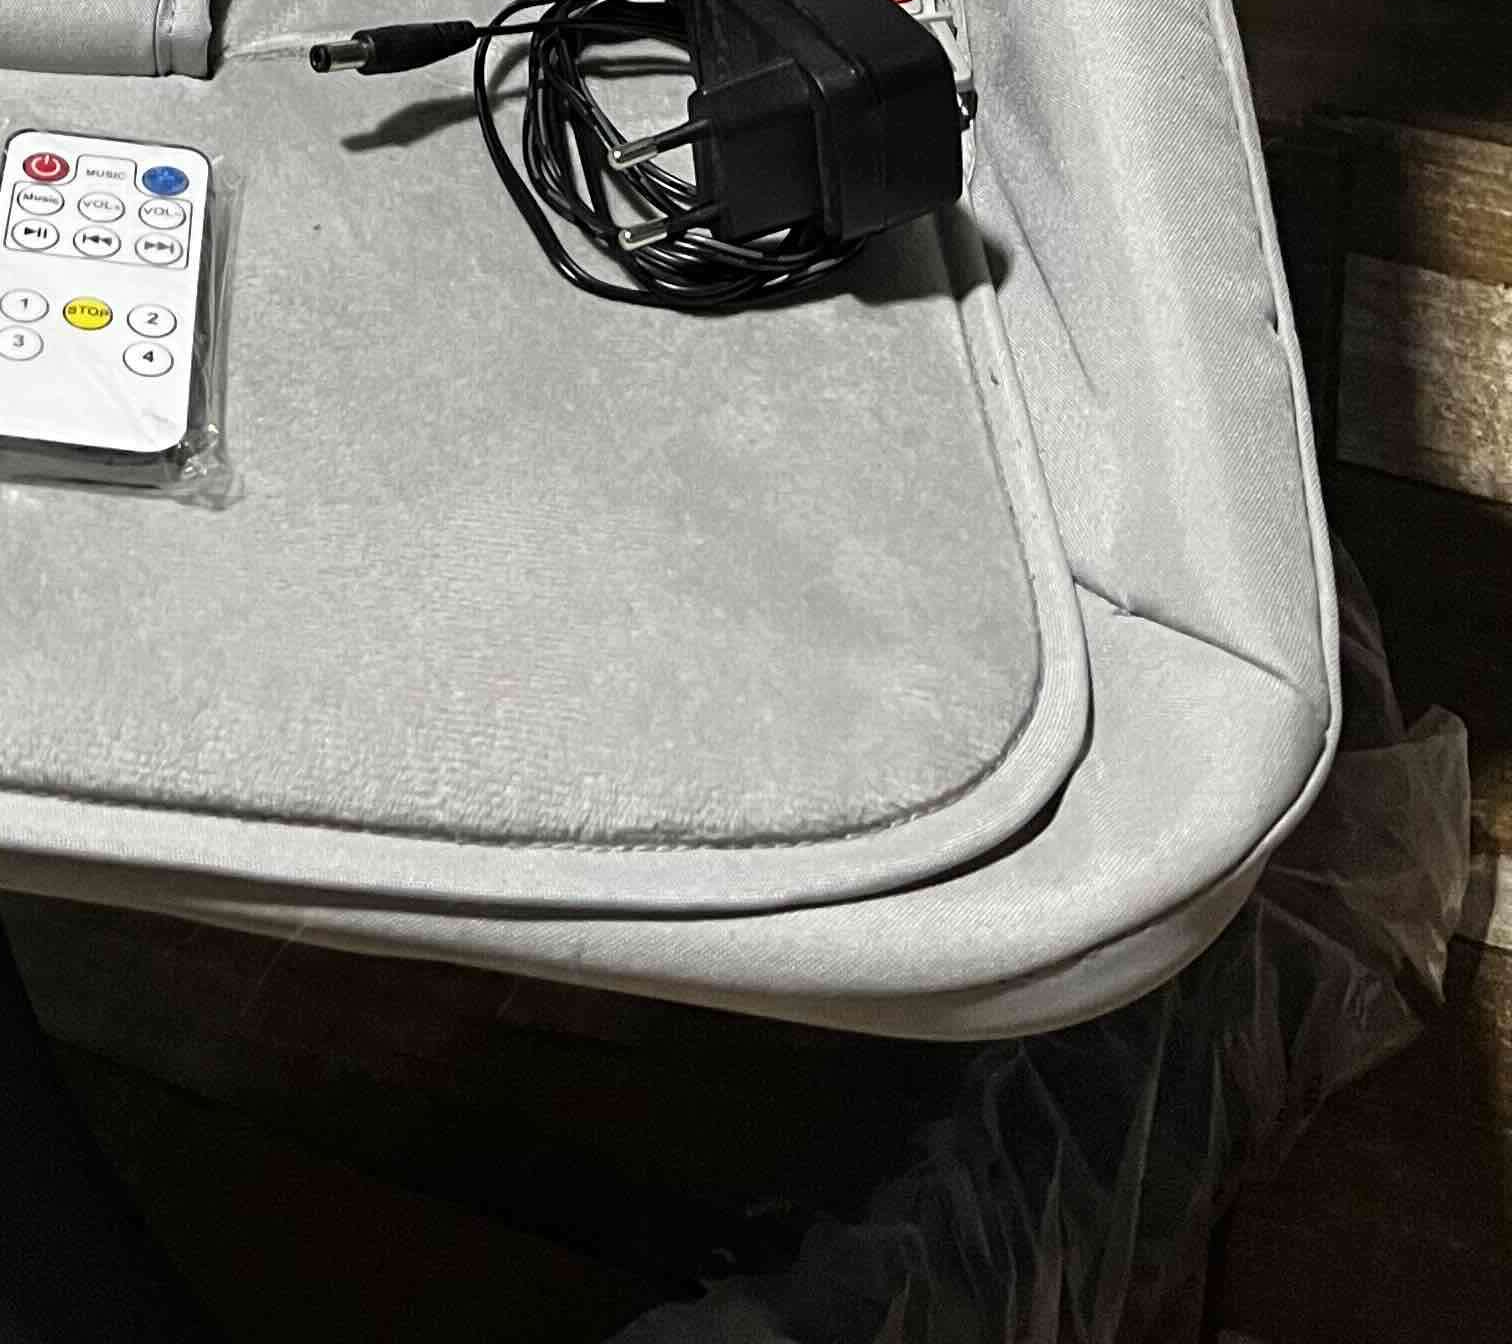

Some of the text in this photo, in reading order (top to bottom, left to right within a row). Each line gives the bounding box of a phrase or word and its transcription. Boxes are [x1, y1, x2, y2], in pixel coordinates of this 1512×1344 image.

[86, 169, 126, 181] MUSIC
[23, 192, 59, 205] Music
[67, 305, 109, 318] STOP
[146, 312, 159, 325] 2
[12, 334, 25, 348] 3
[142, 350, 154, 363] 4
